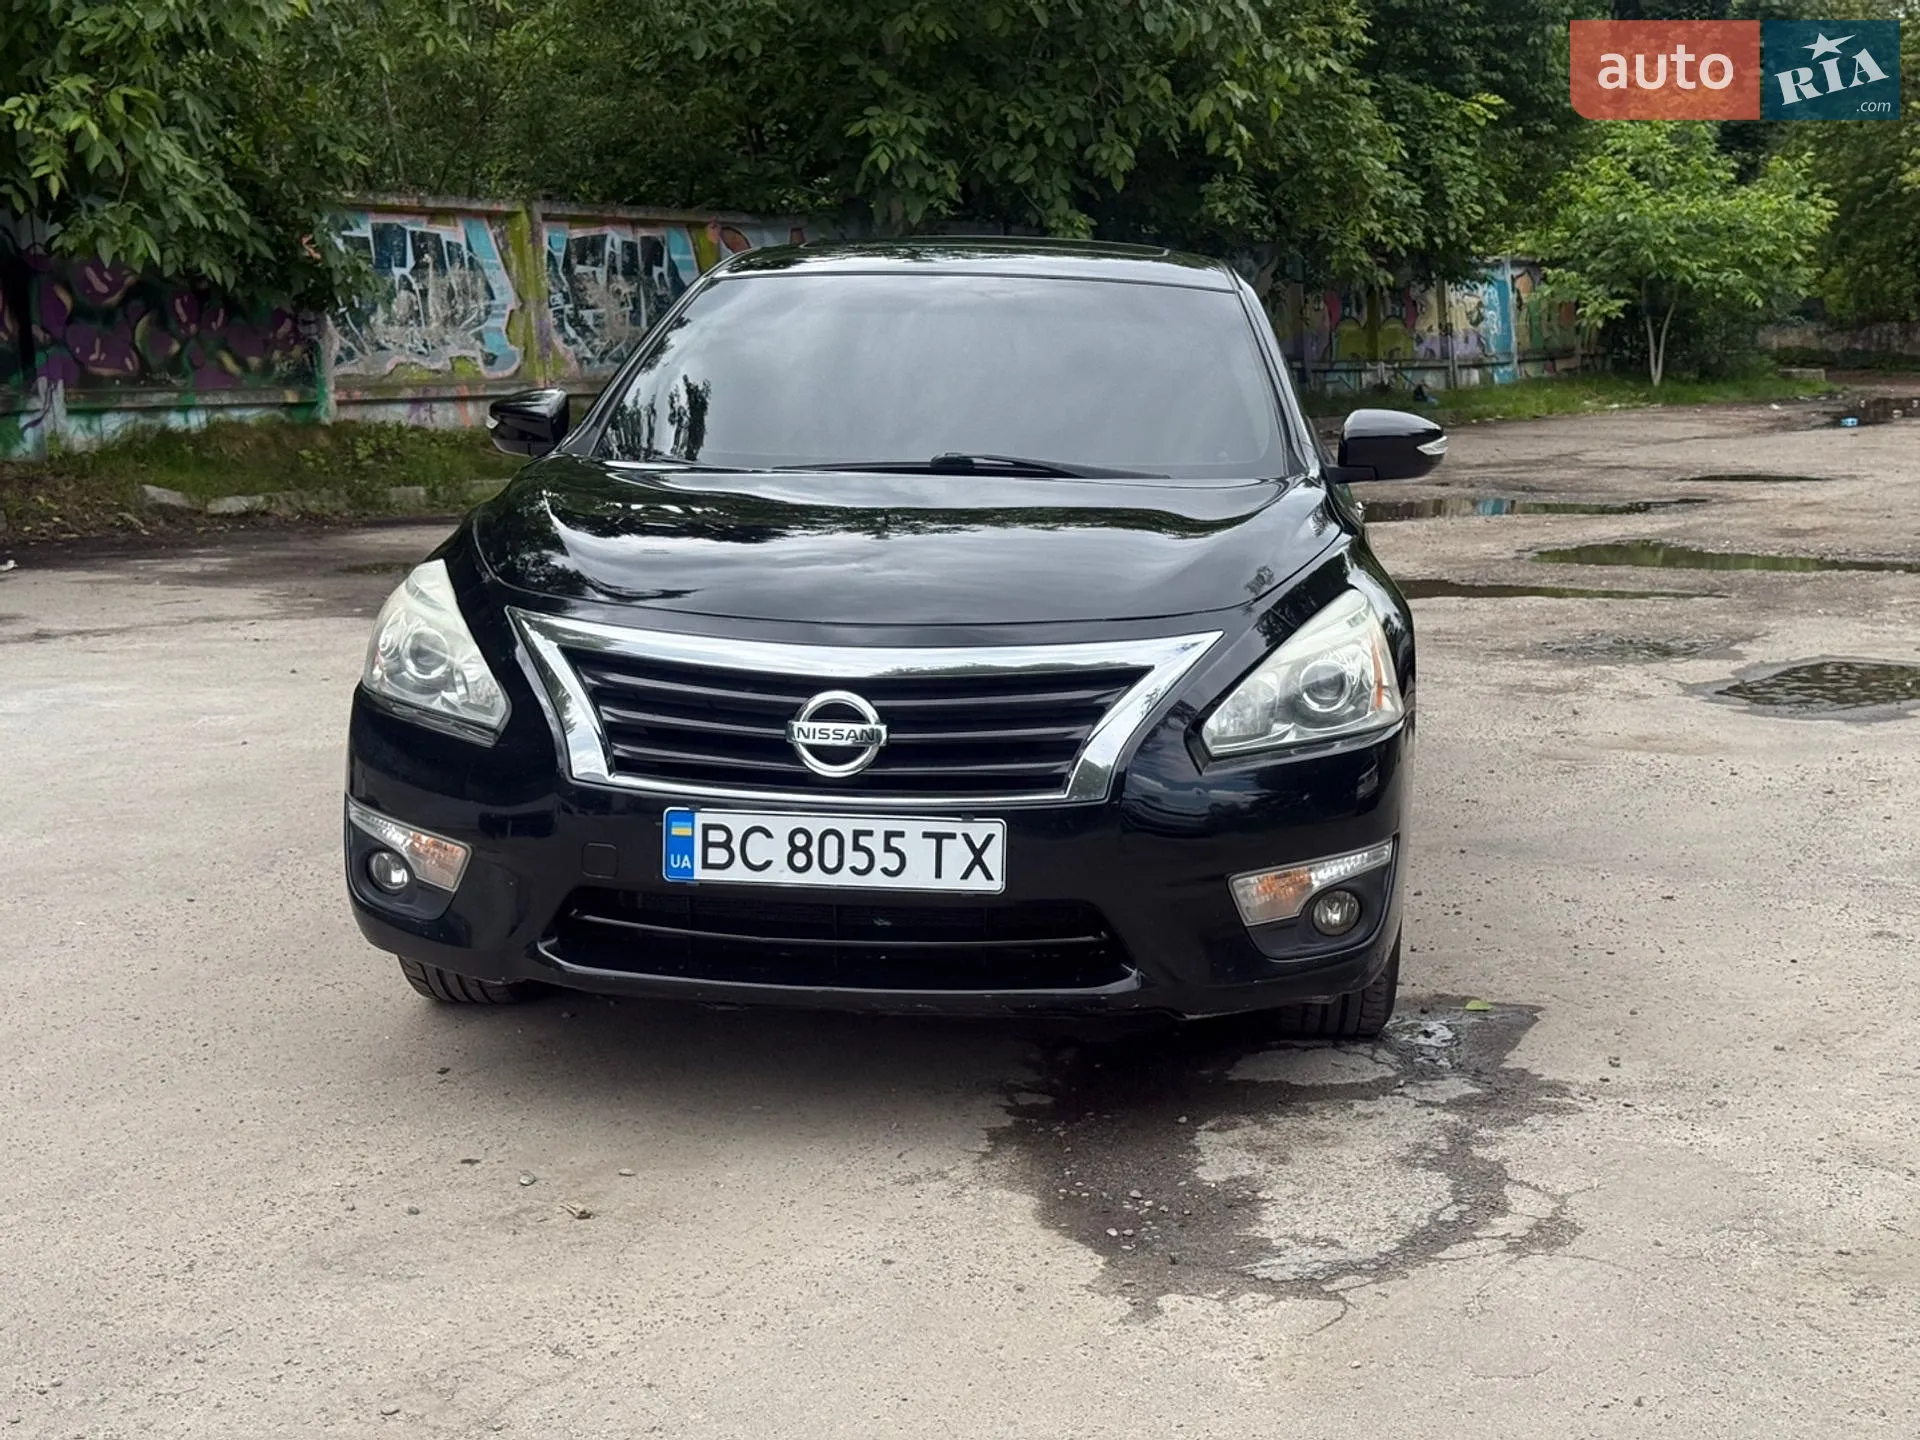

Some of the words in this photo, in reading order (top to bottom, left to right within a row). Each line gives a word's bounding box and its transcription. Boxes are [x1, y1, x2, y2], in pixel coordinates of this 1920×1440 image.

[796, 726, 875, 742] NISSAN
[701, 823, 774, 872] BC
[786, 827, 907, 878] 8055
[921, 831, 996, 881] TX
[670, 854, 692, 869] UA
